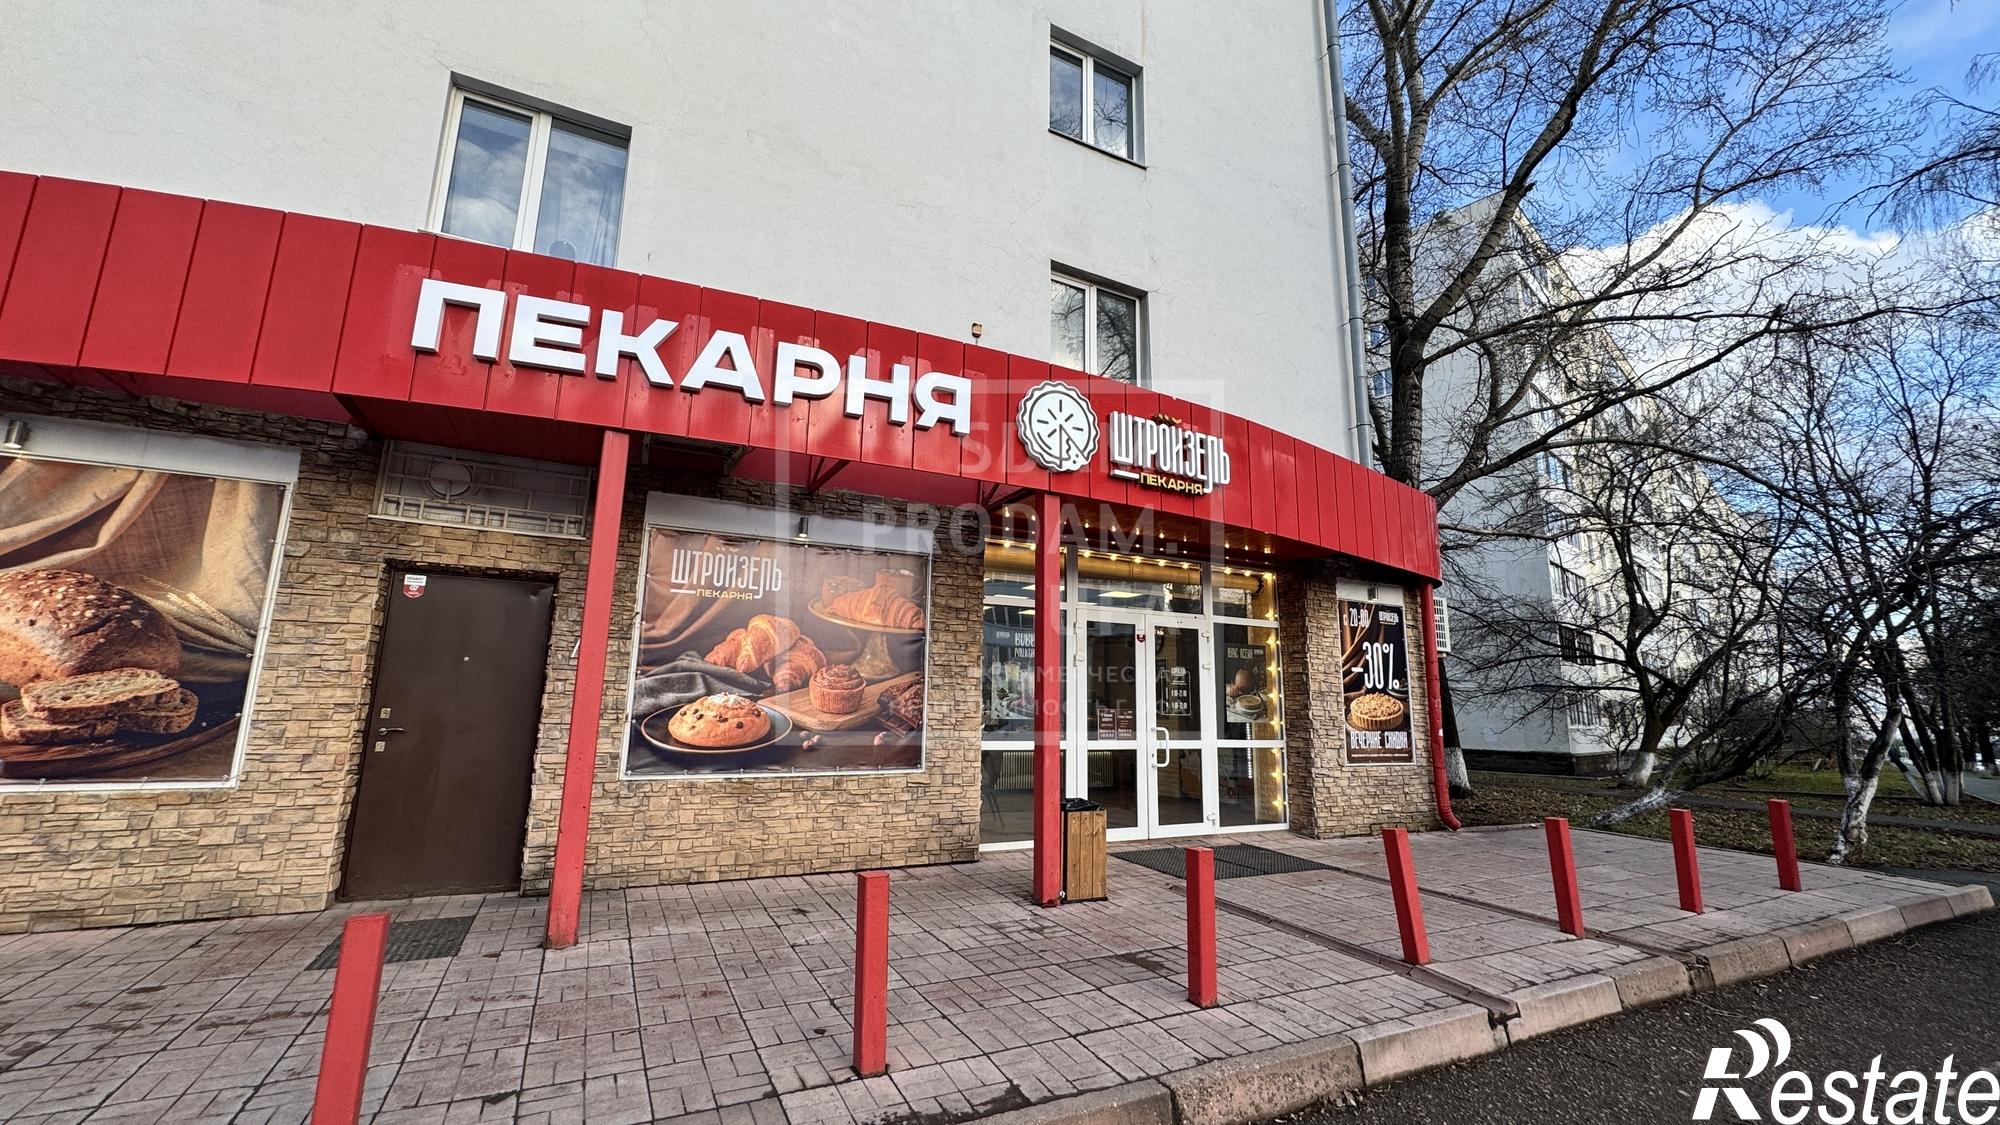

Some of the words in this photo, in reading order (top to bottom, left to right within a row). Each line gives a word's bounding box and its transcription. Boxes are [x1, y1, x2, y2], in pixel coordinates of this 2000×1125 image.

[411, 278, 971, 436] ПЕКАРНЯ
[1140, 472, 1204, 495] ПЕКАРНЯ
[696, 588, 753, 600] ПЕКАРНЯ
[1351, 641, 1400, 690] -30%
